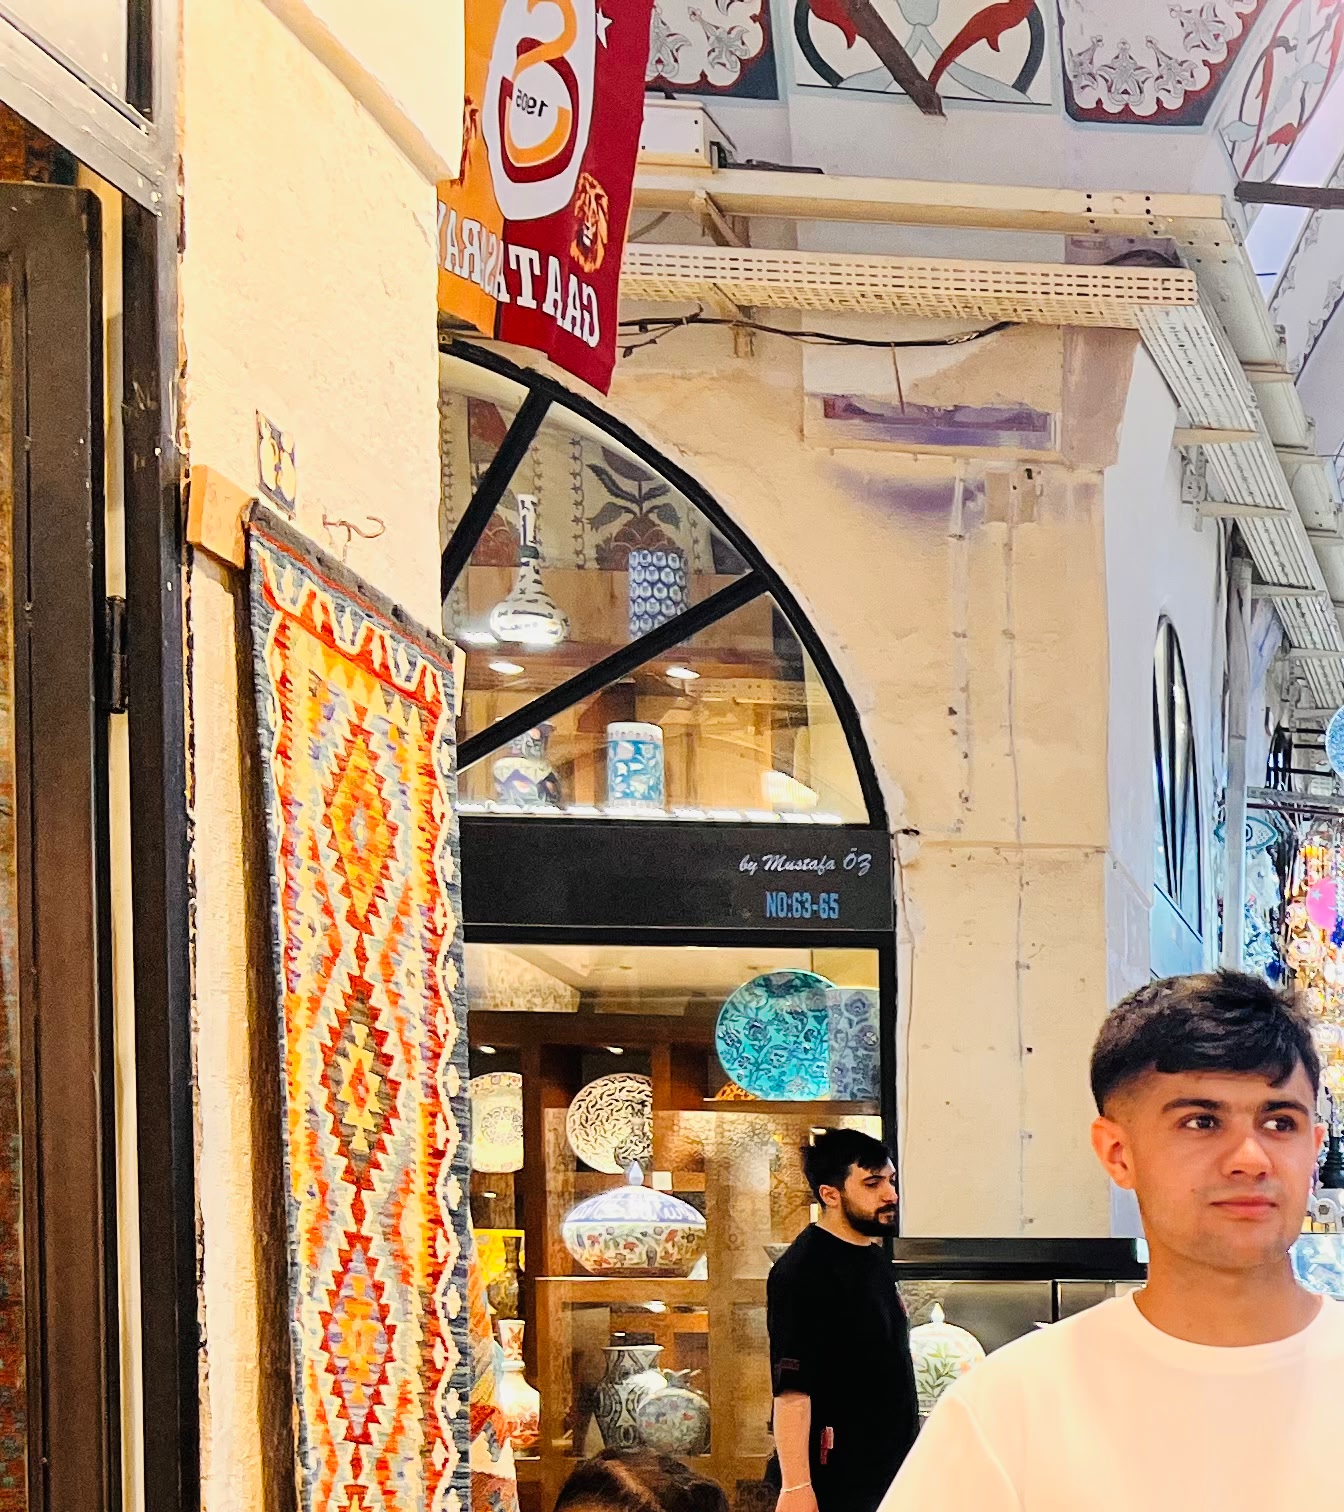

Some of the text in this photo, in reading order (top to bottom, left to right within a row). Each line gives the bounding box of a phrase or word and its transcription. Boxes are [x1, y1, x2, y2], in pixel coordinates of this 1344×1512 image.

[738, 855, 758, 876] by
[763, 853, 836, 876] Mustafa
[766, 890, 840, 920] NO:63-65
